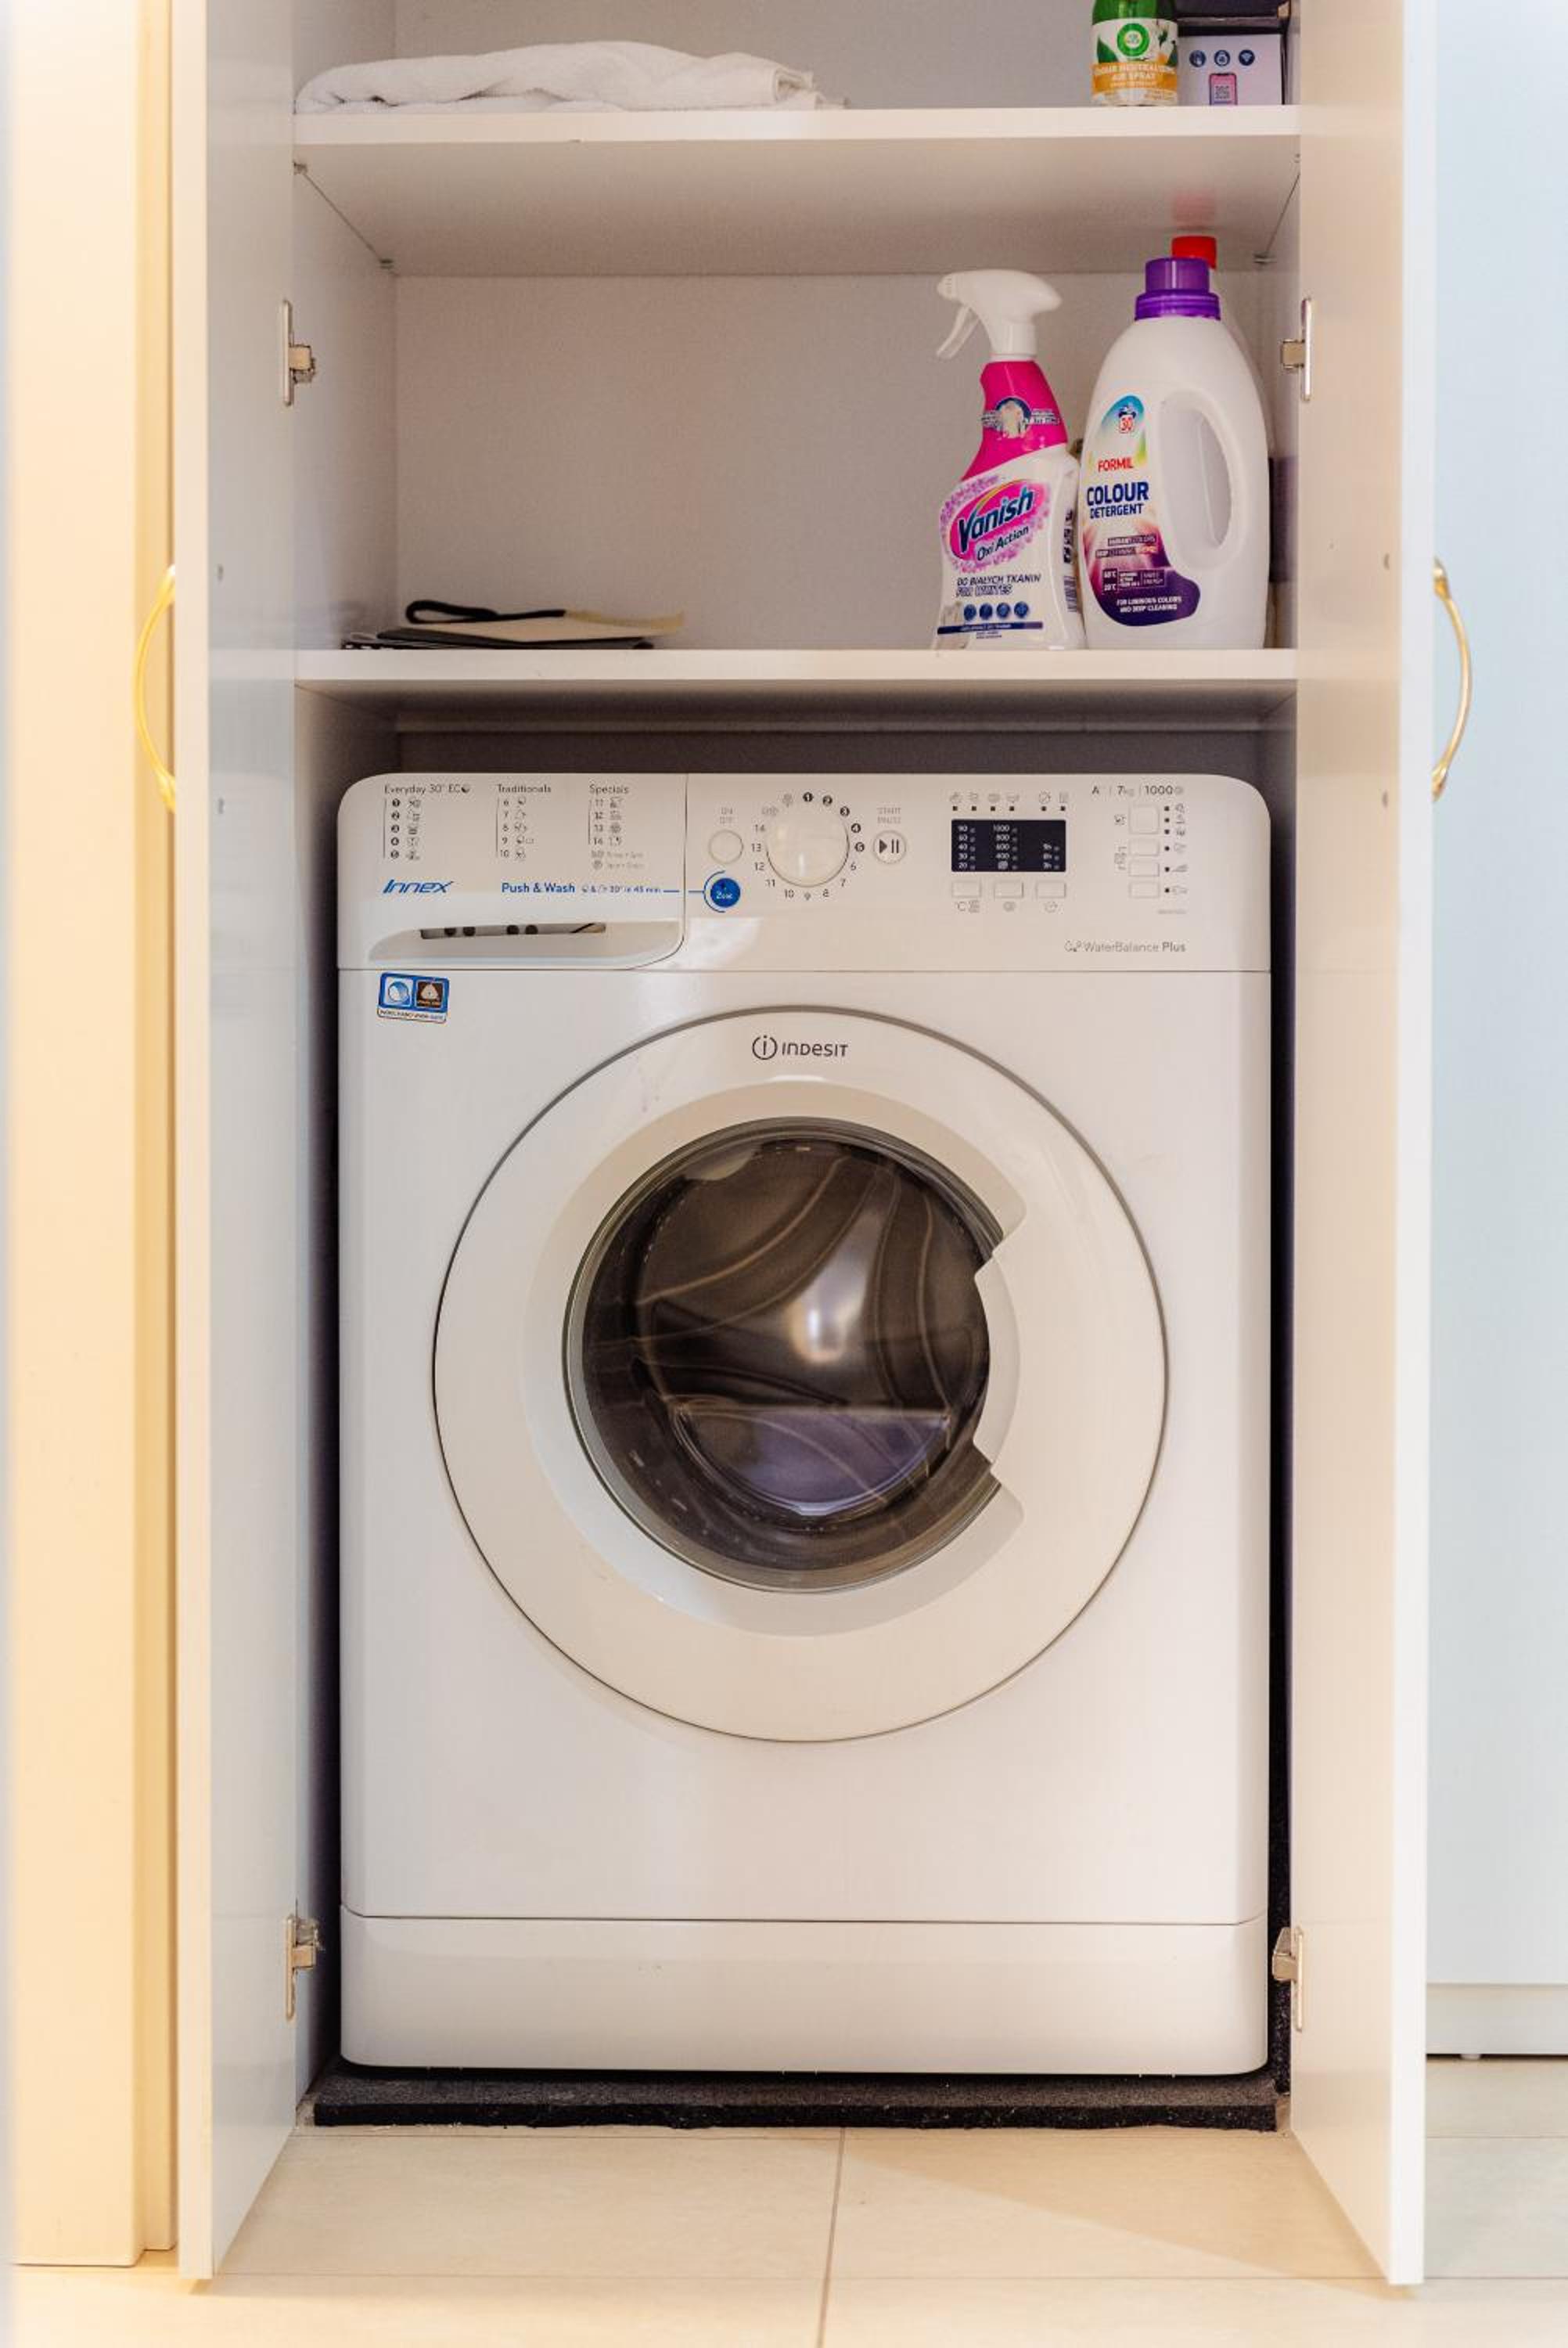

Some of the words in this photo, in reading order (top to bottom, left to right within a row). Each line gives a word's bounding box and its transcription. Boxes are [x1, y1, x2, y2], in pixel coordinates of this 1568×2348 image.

[1098, 457, 1134, 473] FORMIL
[1087, 481, 1149, 506] COLOUR
[1090, 502, 1145, 520] DETERGENT
[958, 486, 1034, 553] Vanish
[977, 543, 994, 561] Oxi
[994, 525, 1030, 552] Action
[1007, 572, 1041, 583] TKANIN
[384, 784, 426, 795] Everyday
[498, 783, 551, 793] Traditionals
[589, 784, 629, 795] Specials
[1145, 784, 1174, 795] 1000
[383, 879, 454, 893] Innex
[502, 882, 530, 893] Push
[533, 883, 541, 893] &
[545, 882, 576, 893] Wash
[1084, 941, 1159, 953] WaterBalance
[1162, 941, 1186, 953] Plus
